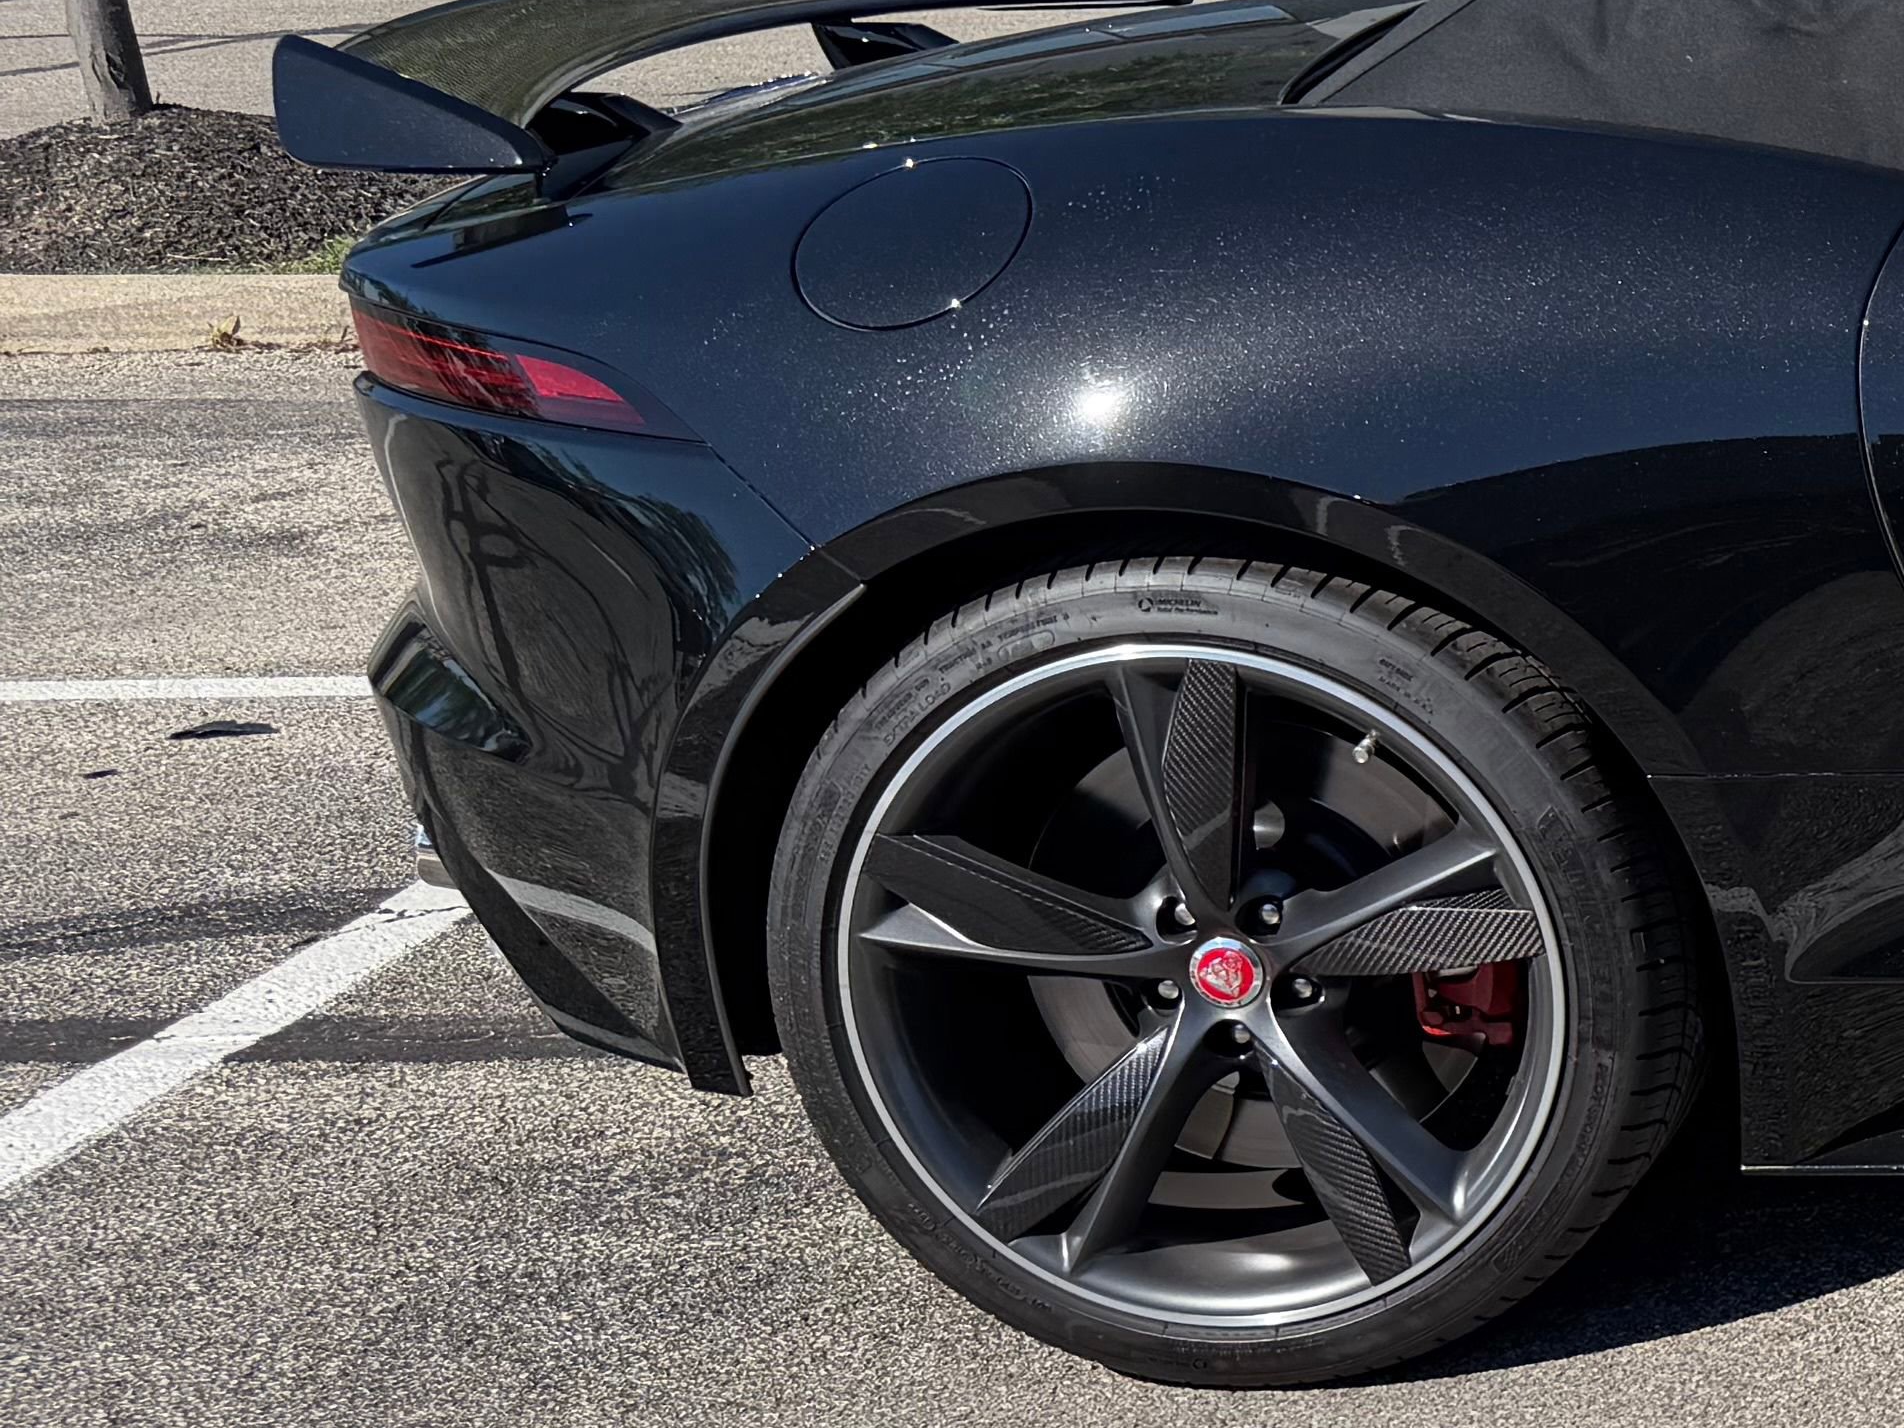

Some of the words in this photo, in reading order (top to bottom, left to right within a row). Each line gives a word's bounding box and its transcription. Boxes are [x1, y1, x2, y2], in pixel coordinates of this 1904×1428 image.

[1157, 598, 1201, 607] MICHELIN
[883, 708, 919, 746] EXTRA
[918, 682, 951, 711] LOAD
